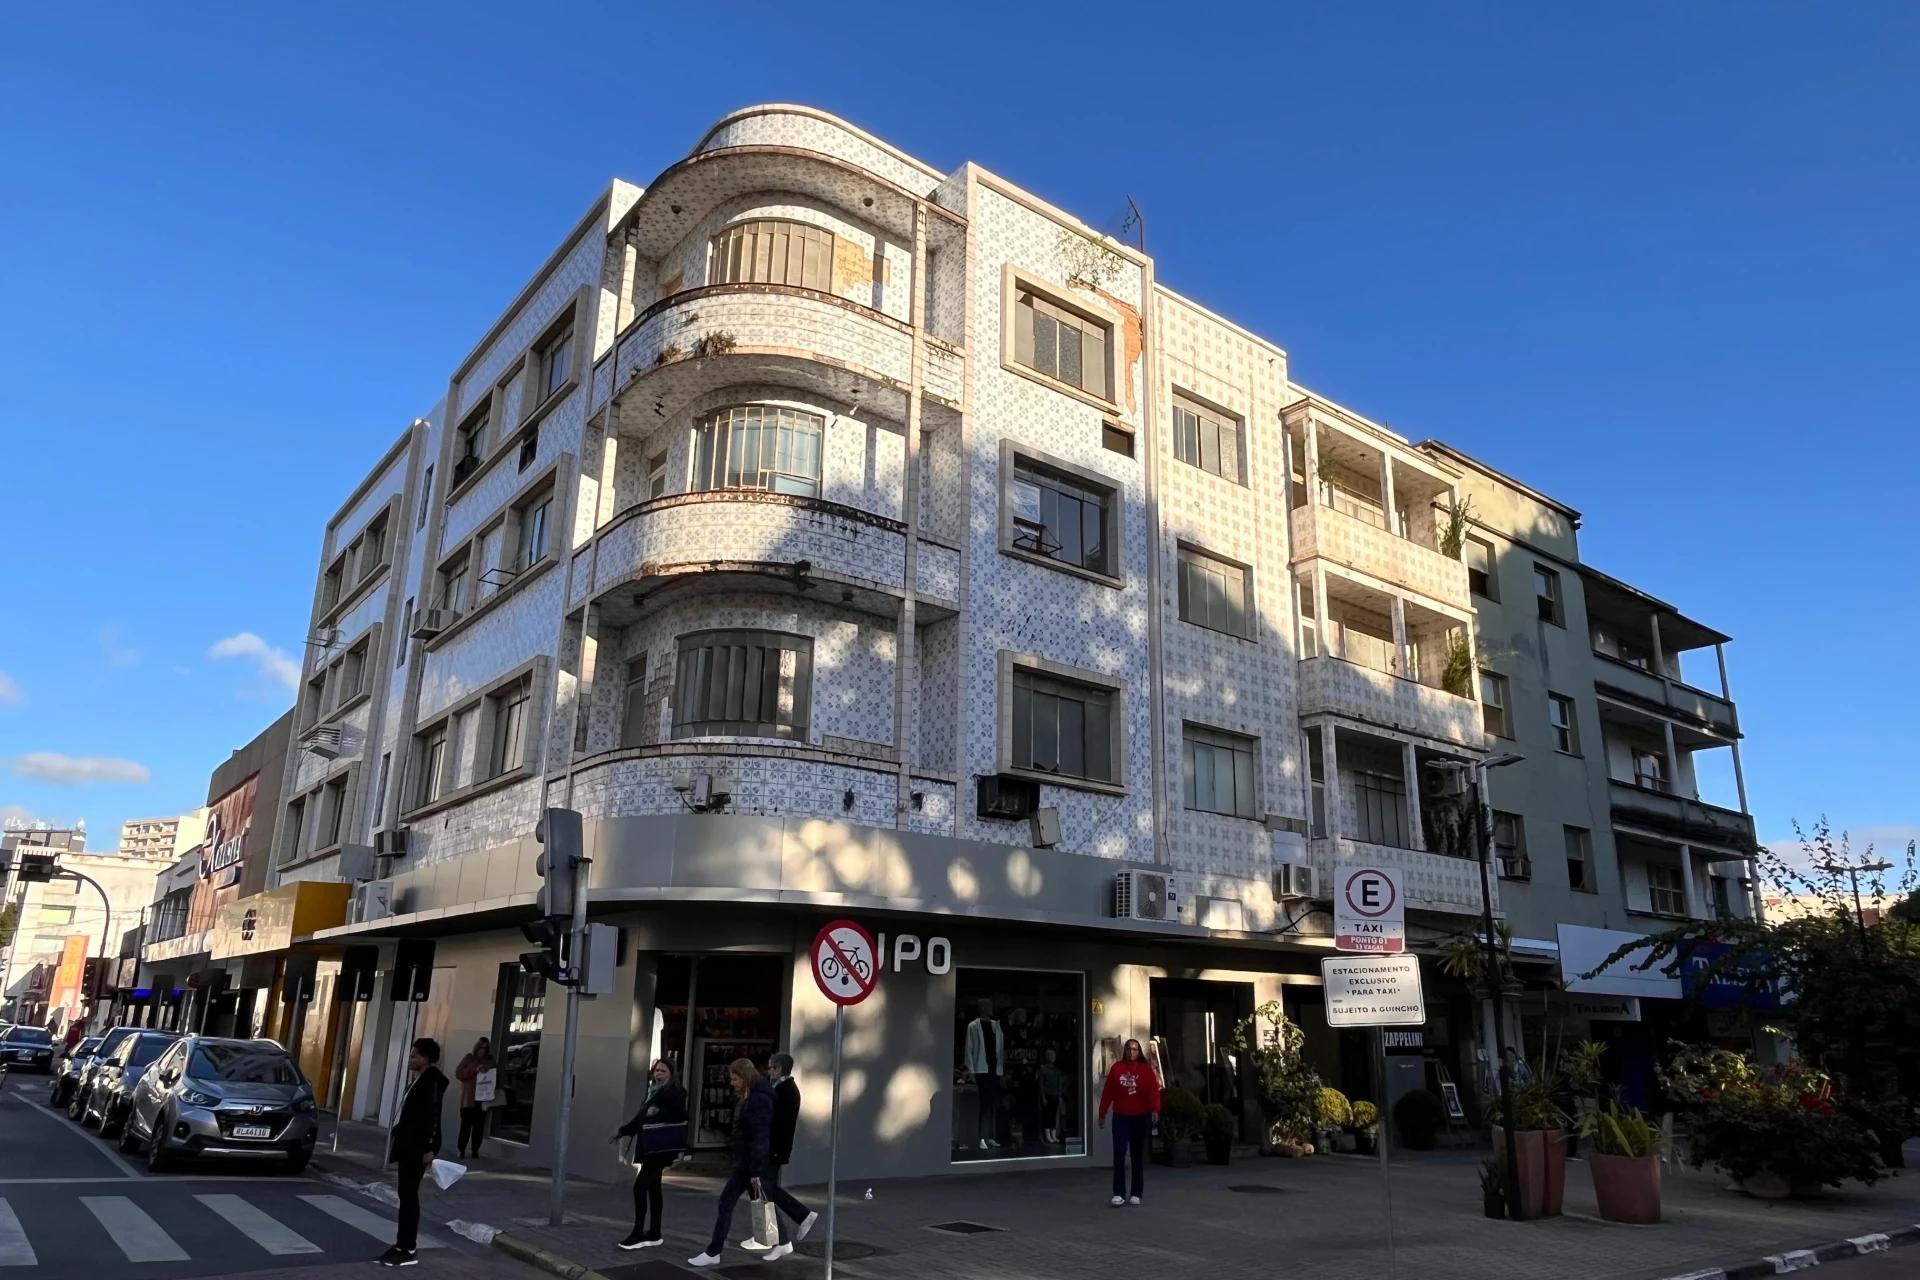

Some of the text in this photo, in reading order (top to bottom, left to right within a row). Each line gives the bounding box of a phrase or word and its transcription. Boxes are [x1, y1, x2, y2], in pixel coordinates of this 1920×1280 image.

[1361, 879, 1380, 907] E
[1350, 936, 1377, 944] PONTO
[1332, 966, 1410, 975] ESTACIONAMENTO
[1348, 977, 1397, 985] EXCLUSIVO
[1379, 1005, 1419, 1013] GUINCHO
[1384, 1031, 1424, 1047] ZAPPELINI
